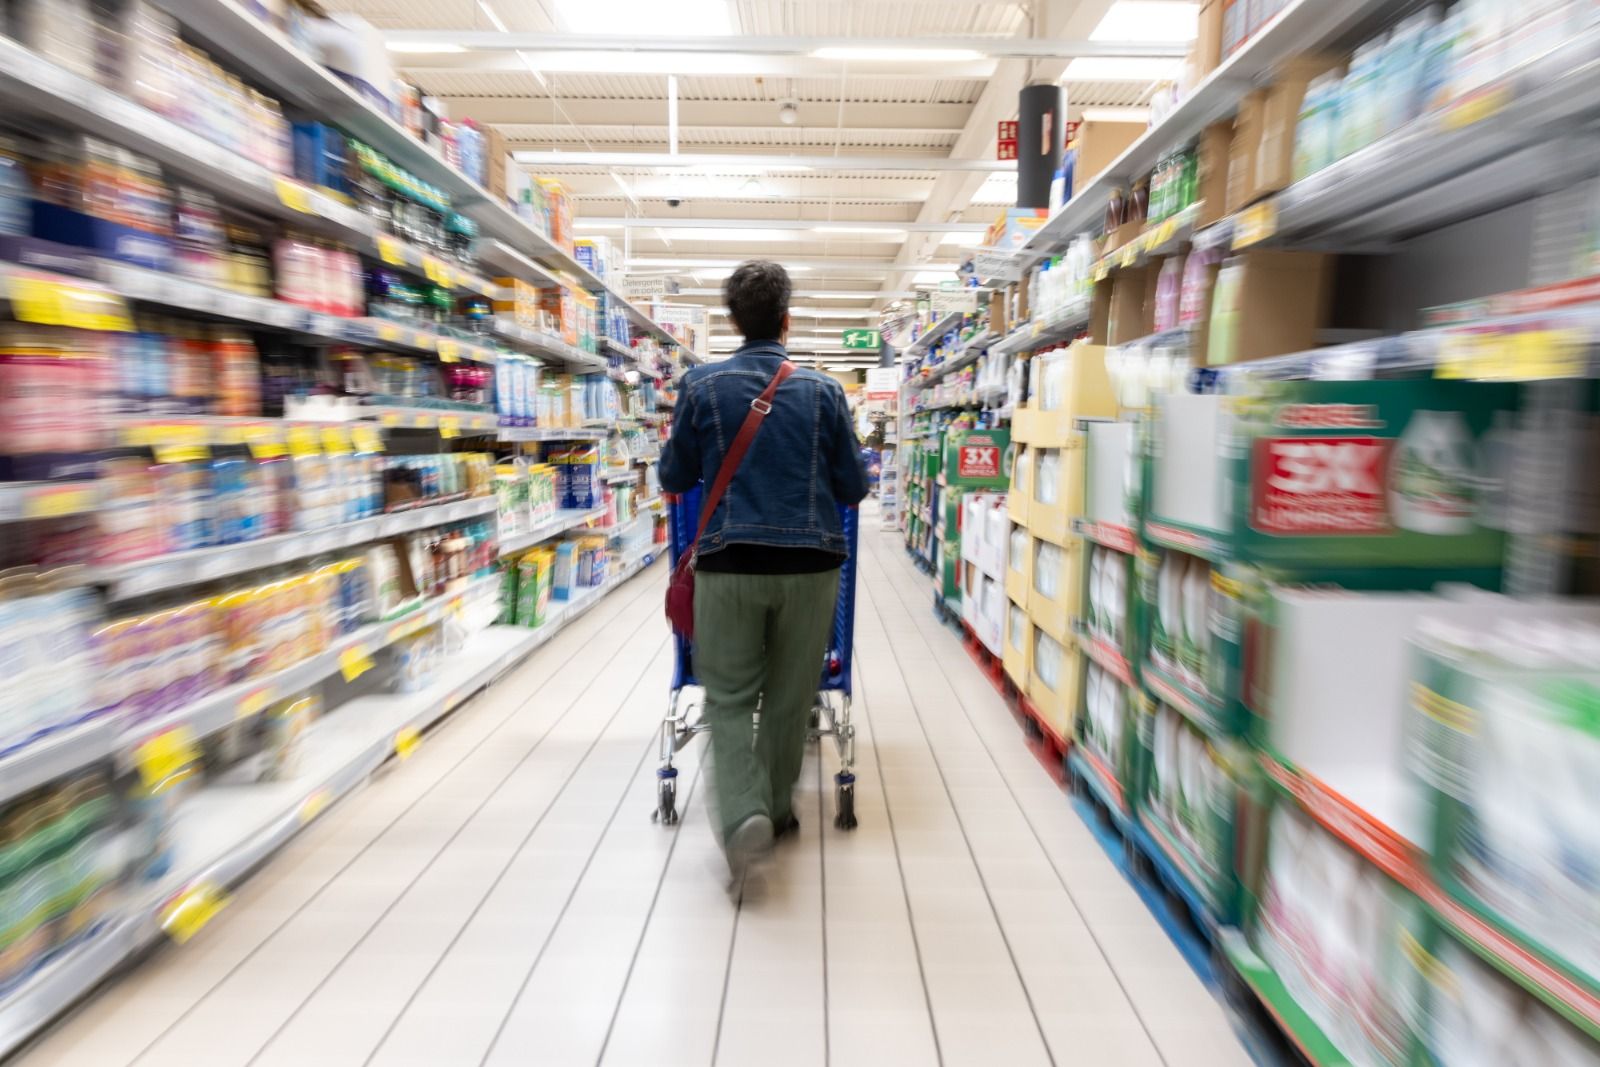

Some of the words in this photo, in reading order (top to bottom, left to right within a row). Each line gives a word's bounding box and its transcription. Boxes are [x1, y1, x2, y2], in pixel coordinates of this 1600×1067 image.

[623, 279, 663, 288] Detergente
[964, 447, 994, 465] 3X
[1266, 442, 1384, 494] 3X
